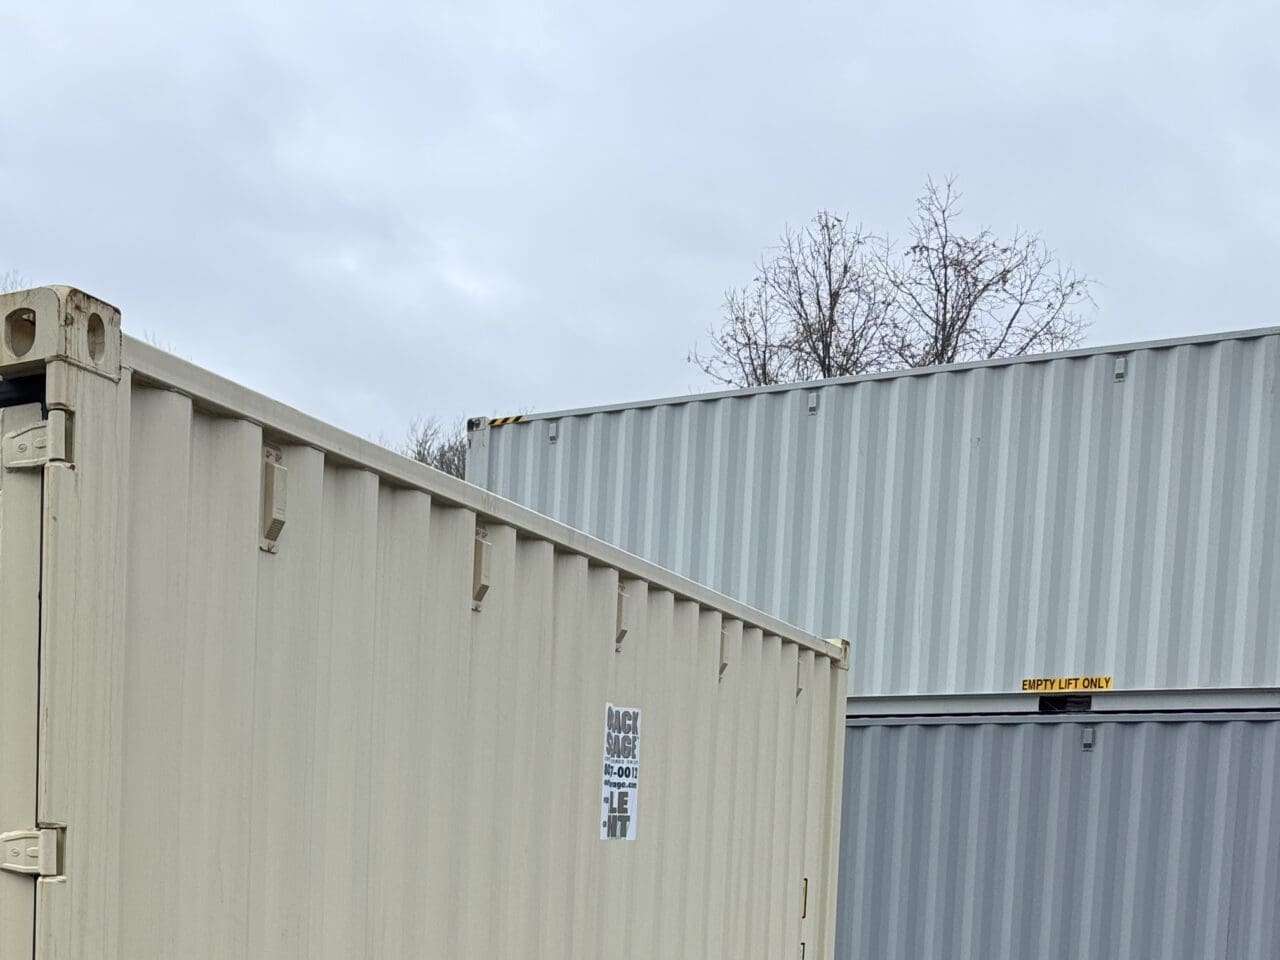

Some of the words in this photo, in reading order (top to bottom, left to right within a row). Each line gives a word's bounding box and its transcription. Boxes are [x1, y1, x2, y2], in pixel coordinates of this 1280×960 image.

[1022, 679, 1056, 690] EMPTY
[1058, 678, 1080, 690] LIFT
[1082, 677, 1111, 689] ONLY
